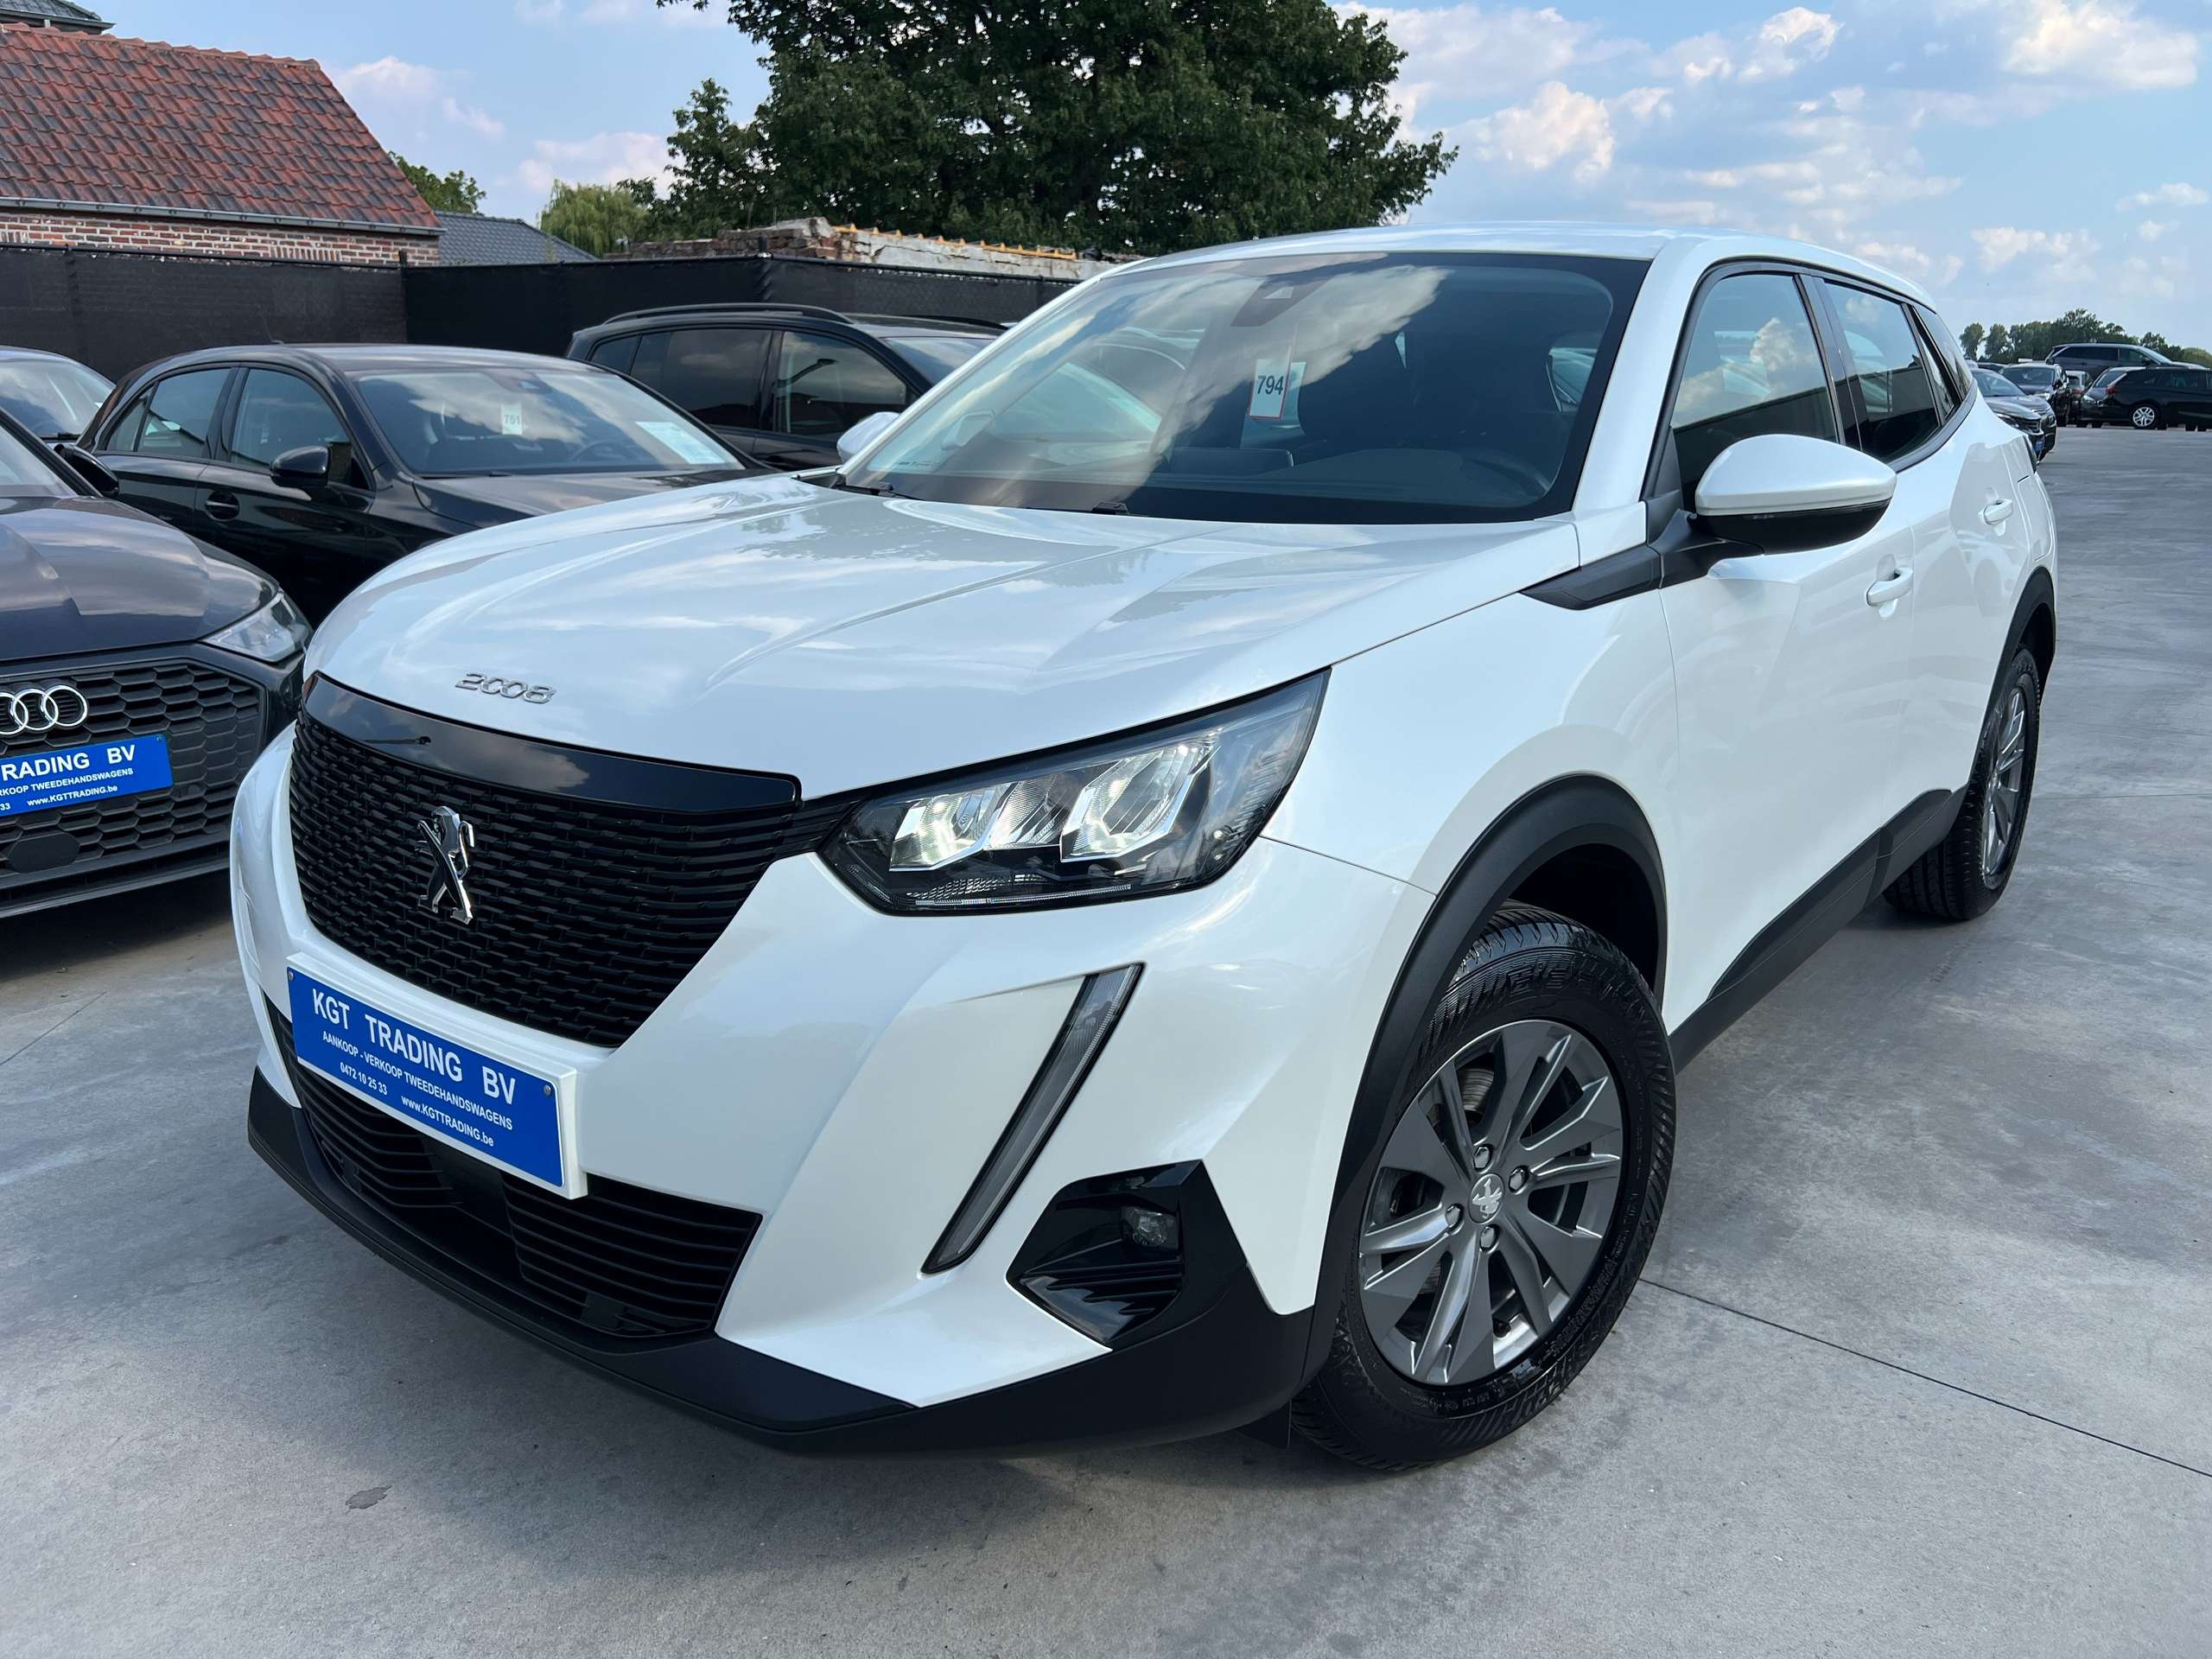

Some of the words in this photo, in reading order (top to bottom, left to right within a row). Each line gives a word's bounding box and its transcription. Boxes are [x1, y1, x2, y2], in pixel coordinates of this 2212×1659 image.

[1257, 375, 1284, 395] 794
[454, 673, 557, 704] 2008
[107, 744, 135, 764] BV
[30, 767, 133, 791] TWEEDEHANDSWAGENS
[27, 785, 118, 806] www.KGTTRADING.be
[313, 988, 350, 1030] KGT
[365, 1014, 463, 1082] TRADING
[482, 1065, 516, 1104] BV
[323, 1031, 359, 1057] AANKOOP
[364, 1052, 403, 1078] VERKOOP
[404, 1071, 512, 1130] TWEEDEHANDSWAGENS
[340, 1062, 357, 1079] 0472
[358, 1071, 367, 1084] 10
[367, 1077, 378, 1090] 25
[378, 1082, 388, 1095] 33
[401, 1096, 493, 1147] www.KGTTRADING.be
